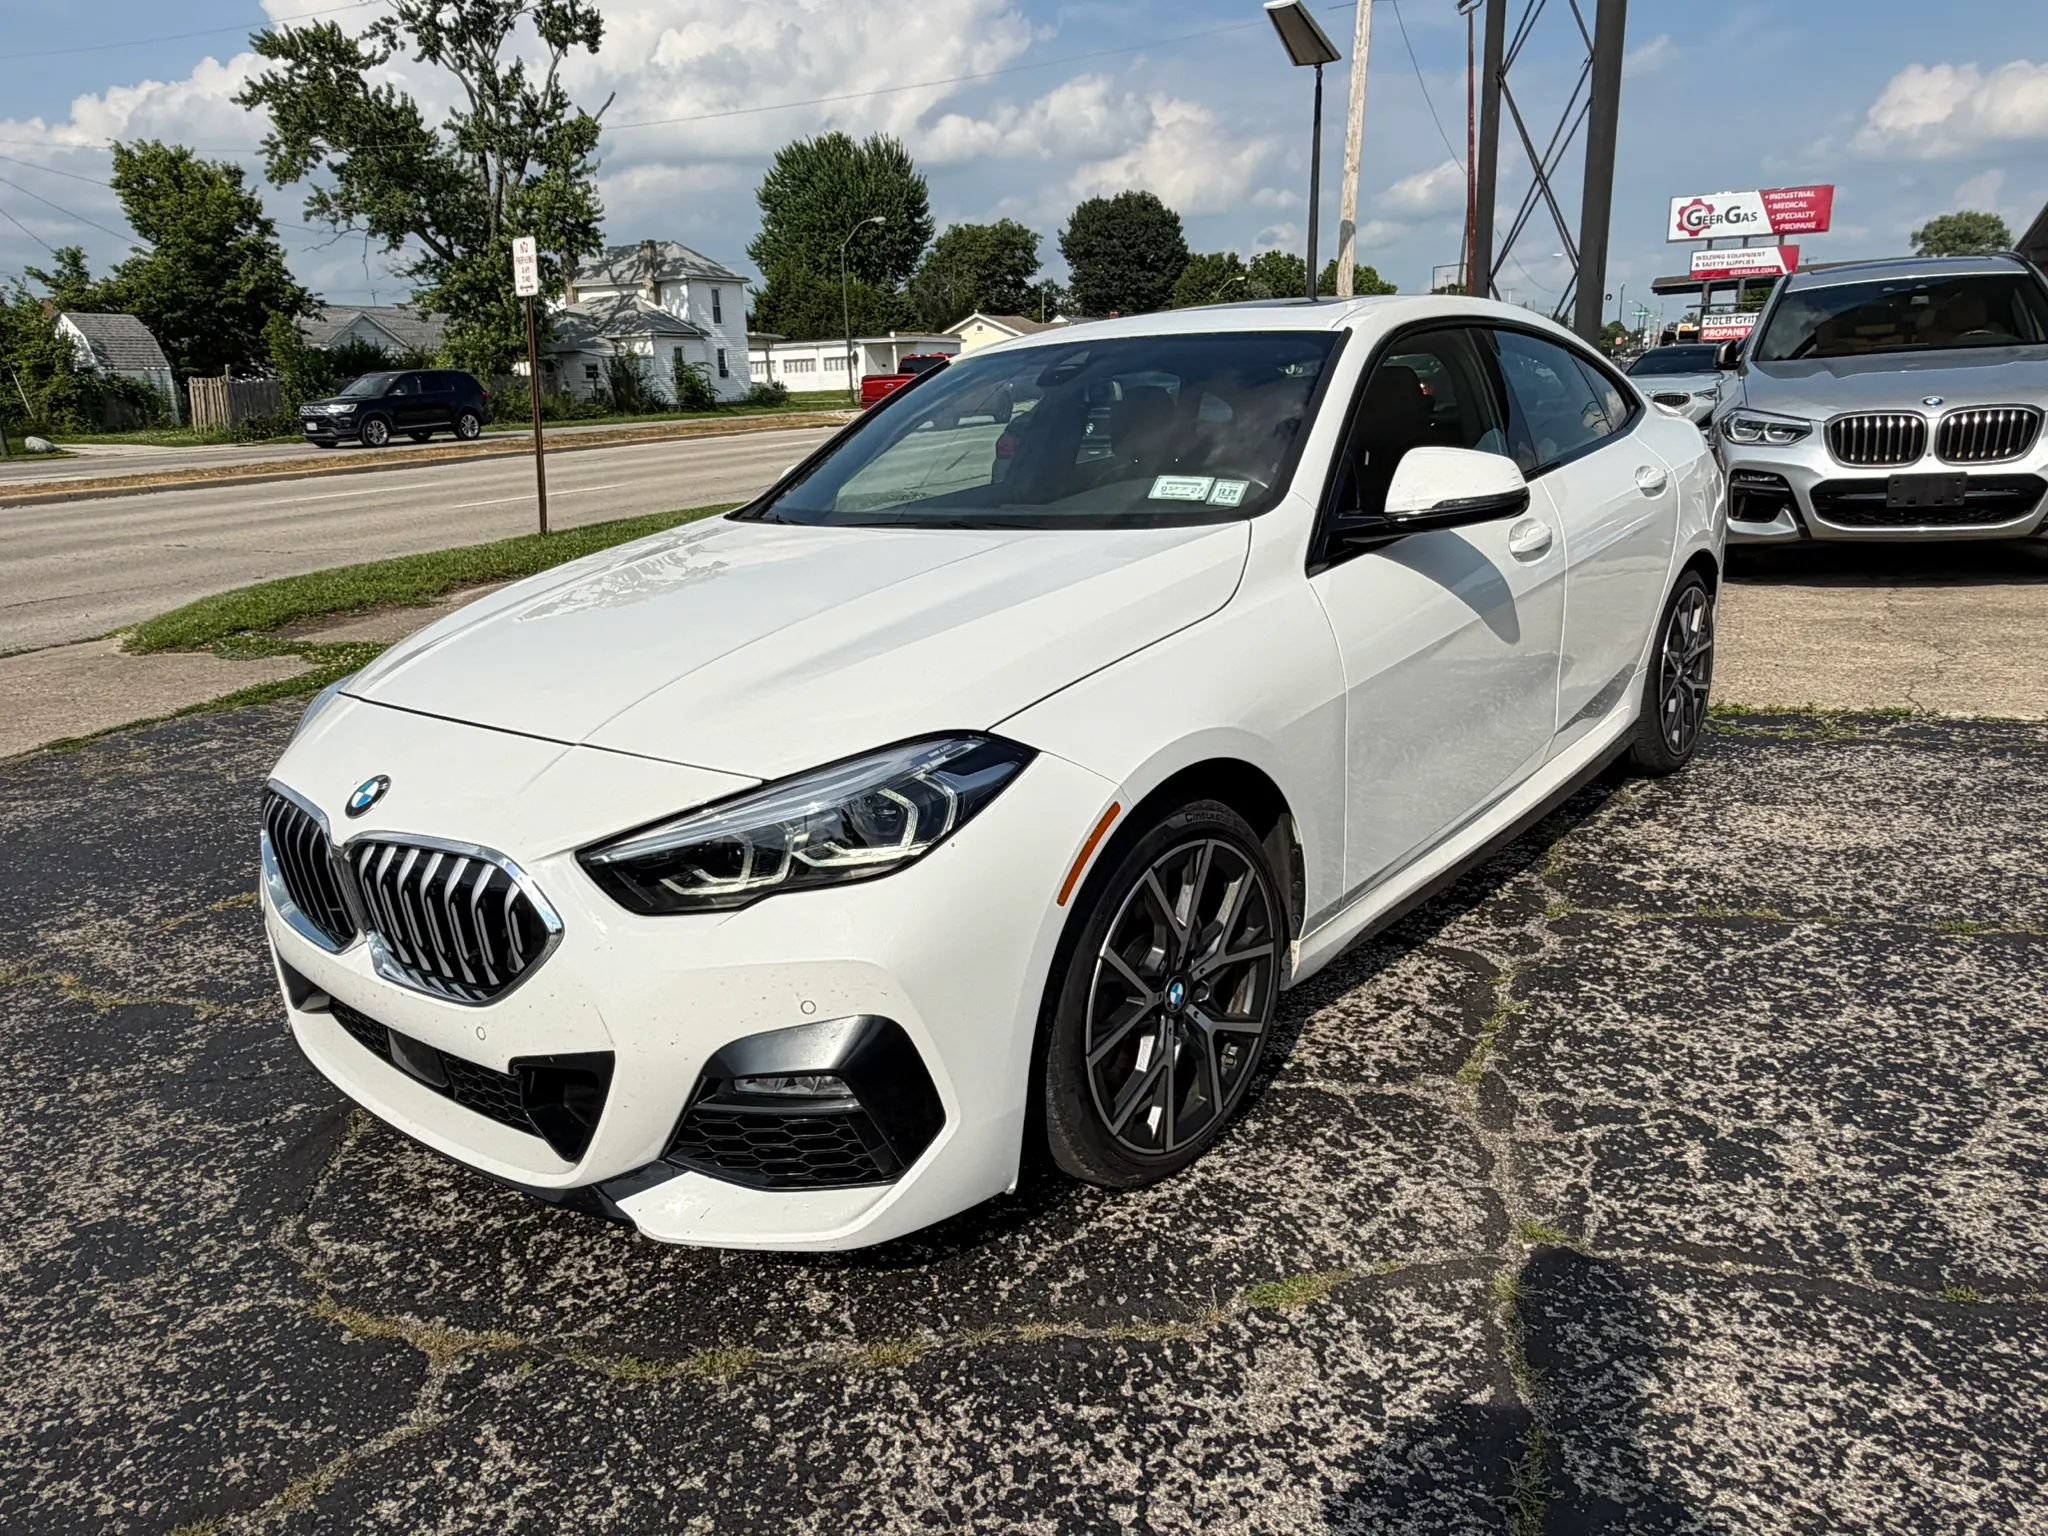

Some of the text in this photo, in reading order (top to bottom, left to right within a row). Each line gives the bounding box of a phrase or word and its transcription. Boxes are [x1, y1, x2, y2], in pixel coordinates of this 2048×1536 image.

[1769, 190, 1816, 200] INDUSTRIAL
[1772, 201, 1808, 209] MEDICAL
[1775, 210, 1816, 220] SPECIALTY
[1779, 221, 1817, 231] PROPANE
[1705, 316, 1732, 326] 20LB
[1703, 328, 1745, 337] PROPANE
